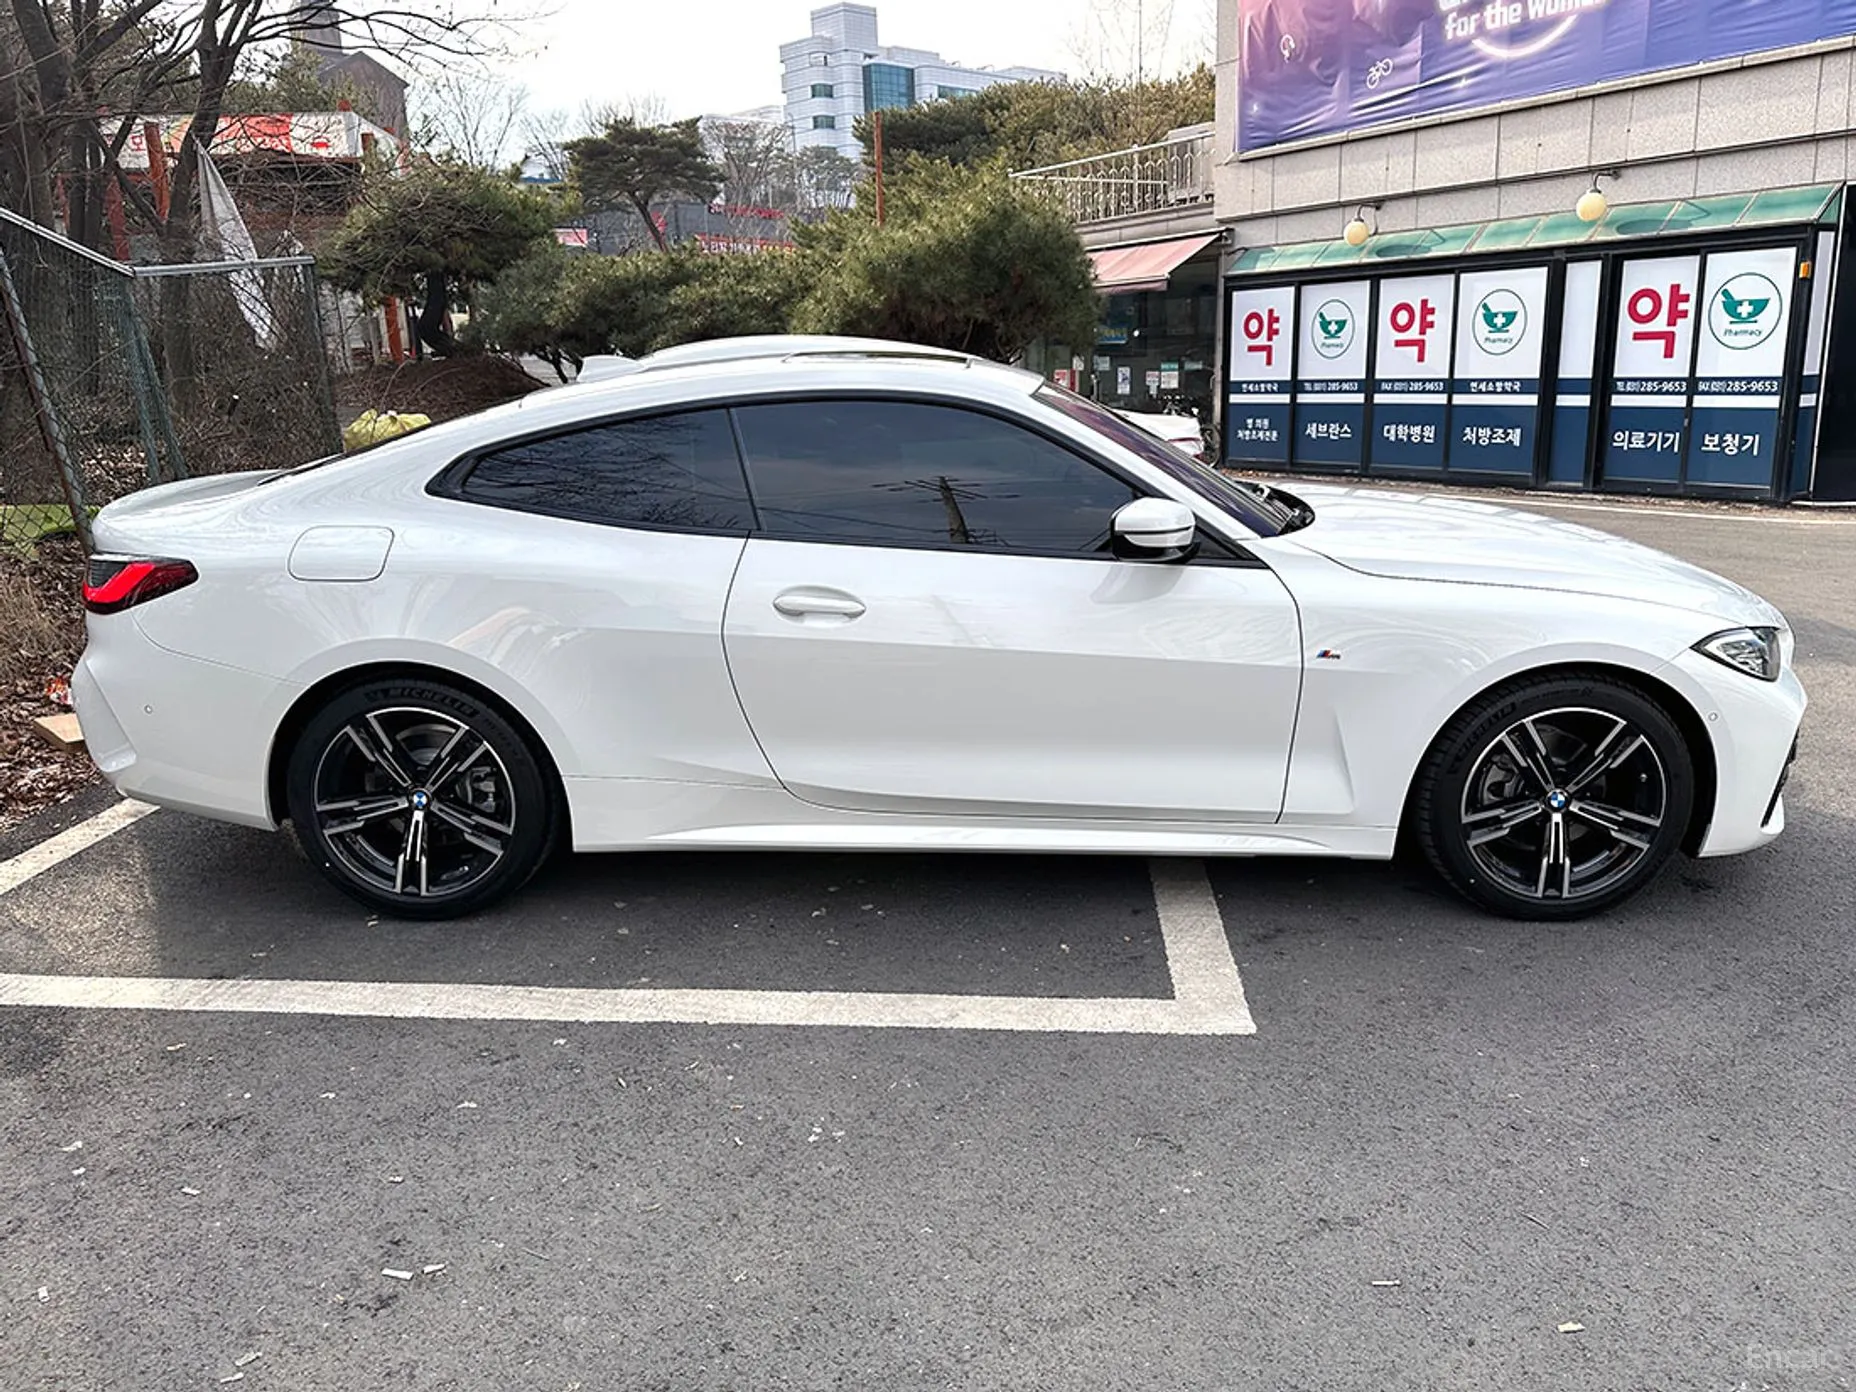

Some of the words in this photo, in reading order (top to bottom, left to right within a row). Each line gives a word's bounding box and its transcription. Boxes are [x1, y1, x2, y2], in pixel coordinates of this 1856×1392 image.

[1445, 12, 1480, 39] for
[1483, 0, 1522, 30] the
[1390, 299, 1435, 362] 약
[1627, 284, 1690, 358] 약
[1243, 308, 1280, 366] 약
[1640, 381, 1687, 392] 285-9653
[1726, 381, 1778, 392] 285-9653
[1305, 422, 1353, 440] 세브란스
[1383, 424, 1436, 443] 대학병원
[1463, 426, 1522, 447] 처방조제
[1612, 431, 1681, 453] 의료기기
[1701, 433, 1761, 456] 보청기
